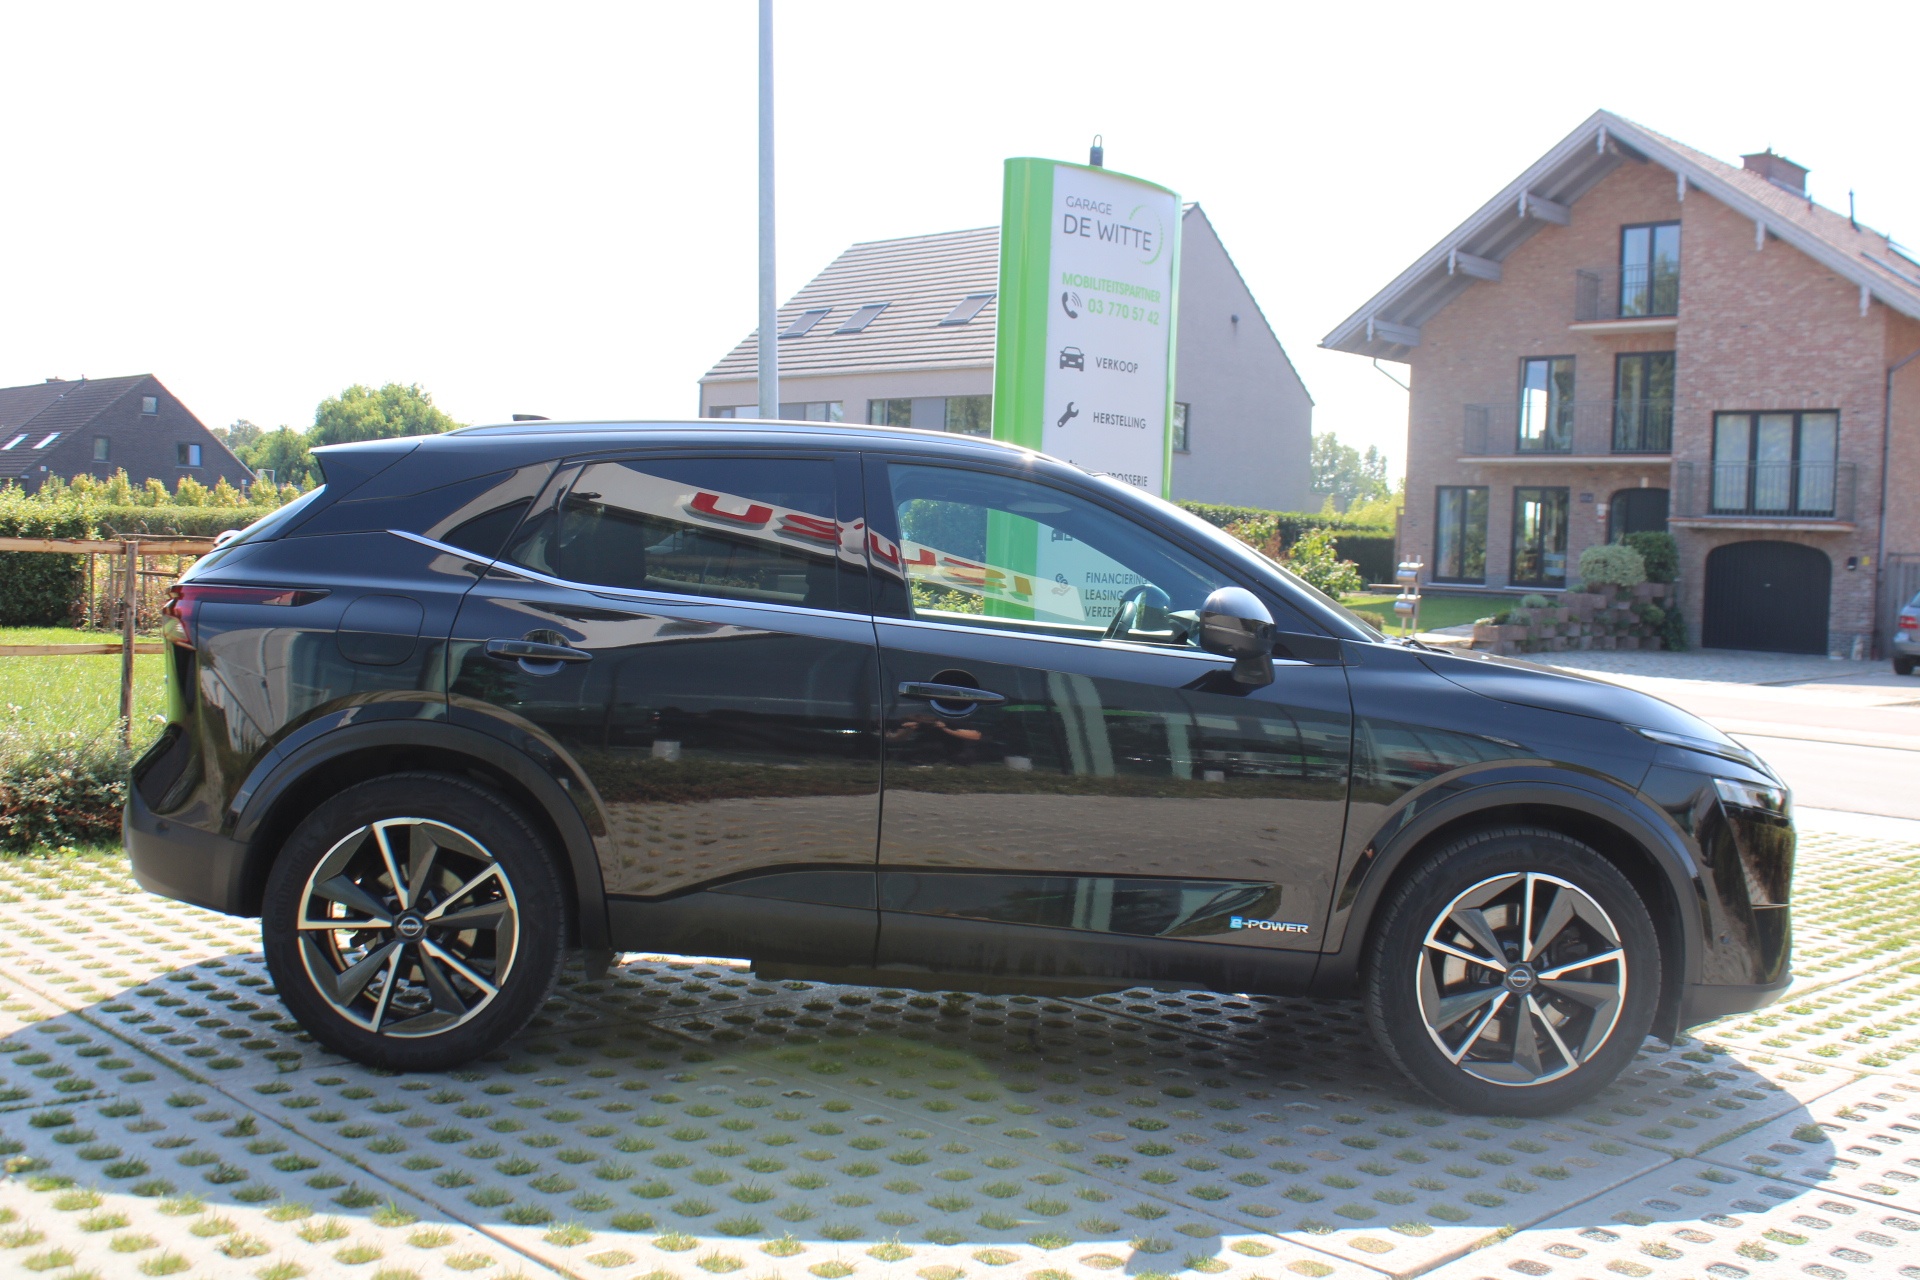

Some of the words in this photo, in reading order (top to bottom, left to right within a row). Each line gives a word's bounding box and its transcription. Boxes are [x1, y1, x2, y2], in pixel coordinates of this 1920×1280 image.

[1066, 195, 1112, 215] GARAGE
[1063, 213, 1091, 238] DE
[1097, 219, 1152, 252] WITTE
[1062, 272, 1161, 303] MOBILITEITSPARTNER
[1088, 298, 1104, 314] 03
[1108, 302, 1129, 319] 770
[1132, 307, 1145, 321] 57
[1147, 311, 1159, 326] 42
[1095, 356, 1138, 374] VERKOOP
[1093, 411, 1146, 429] HERSTELLING
[1086, 571, 1148, 585] FINANCIERING
[1085, 589, 1124, 601] LEASING
[1084, 606, 1119, 618] VERZEK
[1230, 916, 1309, 934] e-POWER
